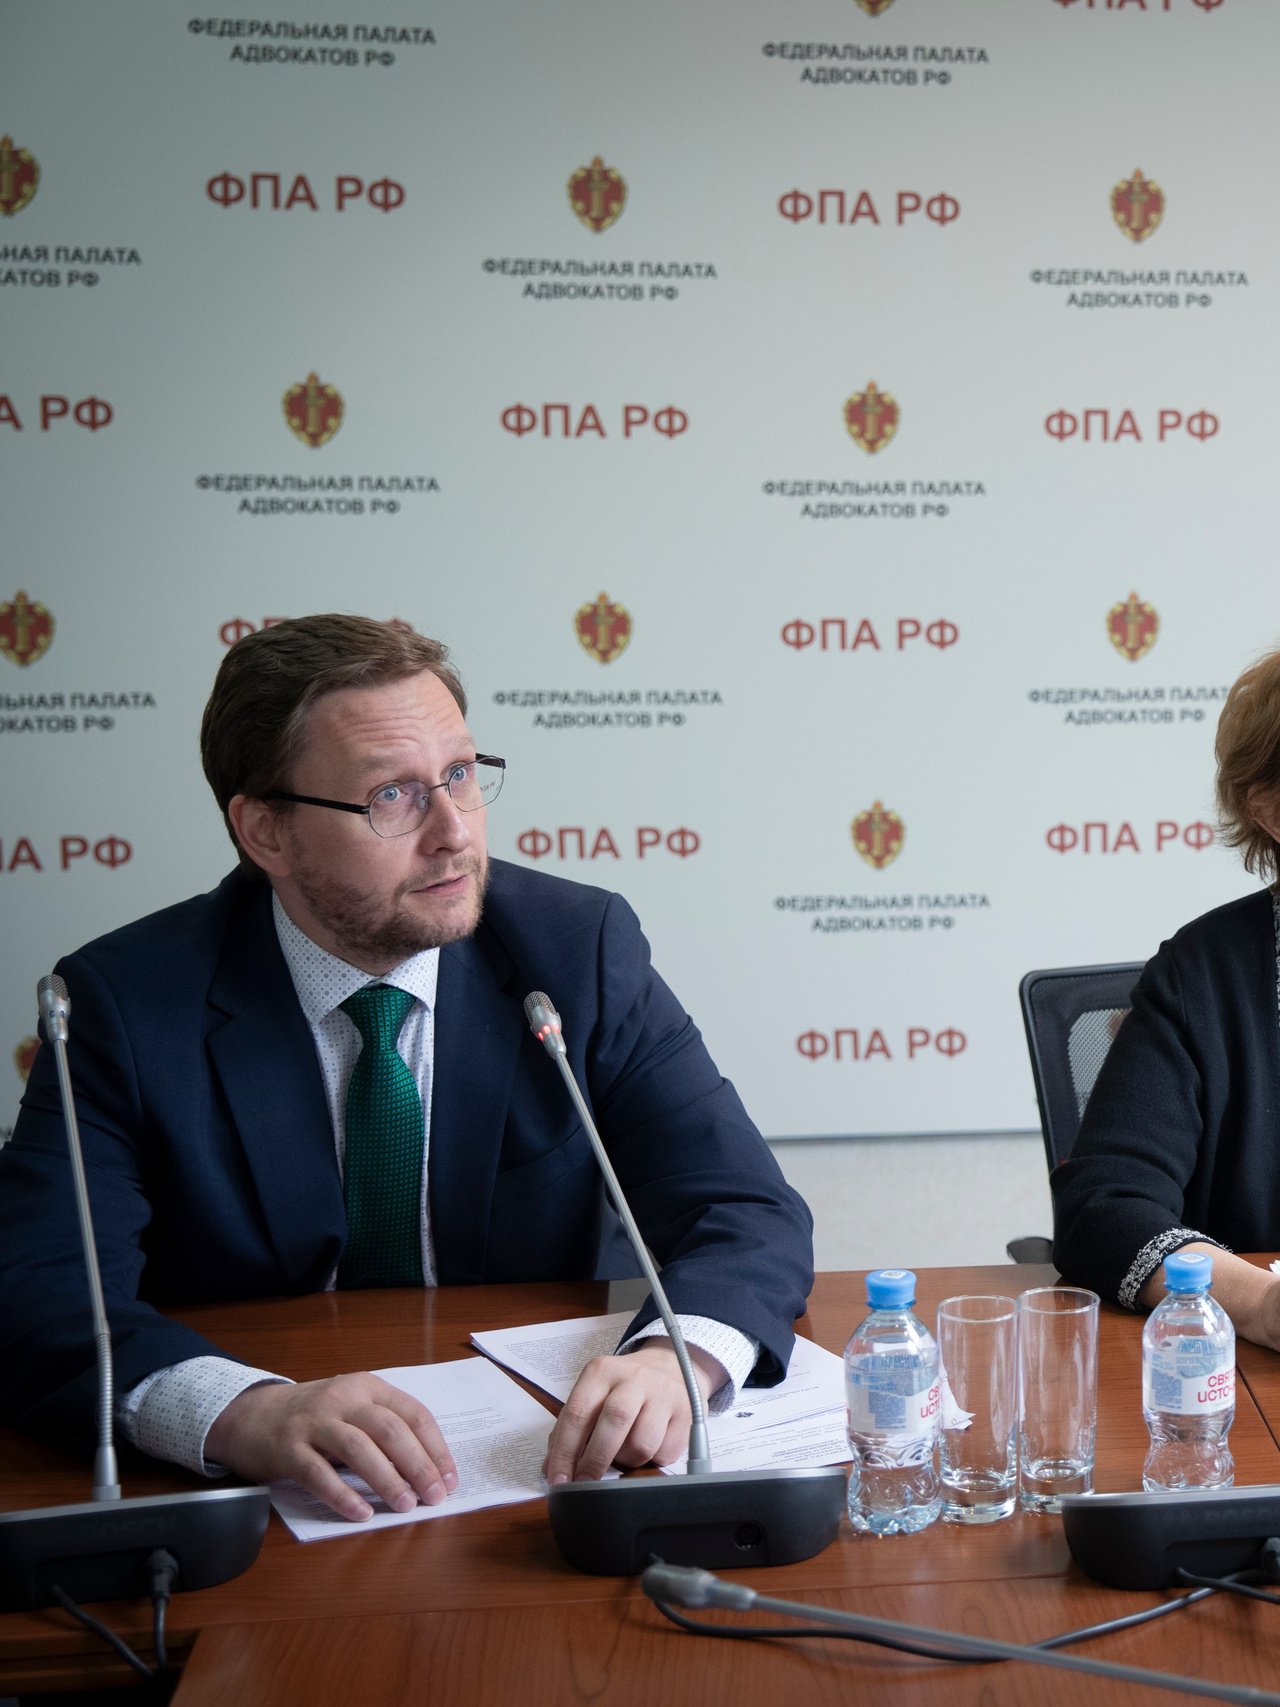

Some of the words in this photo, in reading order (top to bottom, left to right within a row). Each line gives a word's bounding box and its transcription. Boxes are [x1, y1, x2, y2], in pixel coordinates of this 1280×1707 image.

[187, 18, 348, 43] ФЕДЕРАЛЬНАЯ
[353, 25, 436, 45] ПАЛАТА
[230, 44, 359, 66] АДВОКАТОВ
[364, 46, 396, 67] РФ
[762, 42, 908, 63] ФЕДЕРАЛЬНАЯ
[913, 46, 989, 64] ПАЛАТА
[800, 66, 918, 86] АДВОКАТОВ
[923, 69, 952, 86] РФ
[205, 171, 320, 212] ФПА
[335, 175, 406, 214] РФ
[776, 188, 881, 226] ФПА
[896, 190, 961, 227] РФ
[54, 246, 142, 265] ПАЛАТА
[482, 258, 634, 277] ФЕДЕРАЛЬНАЯ
[639, 261, 717, 279] ПАЛАТА
[1030, 269, 1171, 286] ФЕДЕРАЛЬНАЯ
[1175, 270, 1248, 286] ПАЛАТА
[67, 270, 99, 288] РФ
[522, 282, 645, 301] АДВОКАТОВ
[649, 284, 679, 301] РФ
[1067, 291, 1180, 309] АДВОКАТОВ
[1185, 293, 1212, 308] РФ
[39, 394, 114, 433] РФ
[499, 402, 607, 439] ФПА
[622, 403, 690, 440] РФ
[1043, 407, 1143, 443] ФПА
[1157, 408, 1220, 443] РФ
[195, 474, 353, 492] ФЕДЕРАЛЬНАЯ
[358, 476, 440, 492] ПАЛАТА
[762, 480, 906, 497] ФЕДЕРАЛЬНАЯ
[911, 480, 986, 496] ПАЛАТА
[238, 497, 365, 516] АДВОКАТОВ
[370, 498, 401, 514] РФ
[800, 502, 917, 520] АДВОКАТОВ
[921, 502, 949, 518] РФ
[780, 617, 882, 652] ФПА
[896, 617, 960, 652] РФ
[70, 692, 157, 709] ПАЛАТА
[492, 690, 642, 707] ФЕДЕРАЛЬНАЯ
[646, 690, 723, 706] ПАЛАТА
[1029, 688, 1165, 704] ФЕДЕРАЛЬНАЯ
[1169, 686, 1229, 702] ПАЛАТ
[83, 715, 115, 731] РФ
[533, 711, 653, 729] АДВОКАТОВ
[657, 712, 686, 727] РФ
[1064, 709, 1174, 725] АДВОКАТОВ
[1179, 708, 1206, 723] РФ
[516, 826, 622, 861] ФПА
[635, 826, 702, 860] РФ
[1045, 821, 1142, 855] ФПА
[1155, 820, 1215, 853] РФ
[59, 834, 134, 872] РФ
[773, 895, 914, 912] ФЕДЕРАЛЬНАЯ
[918, 894, 991, 909] ПАЛАТА
[811, 916, 924, 933] АДВОКАТОВ
[928, 915, 955, 930] РФ
[795, 1027, 894, 1063] ФПА
[906, 1026, 968, 1060] РФ
